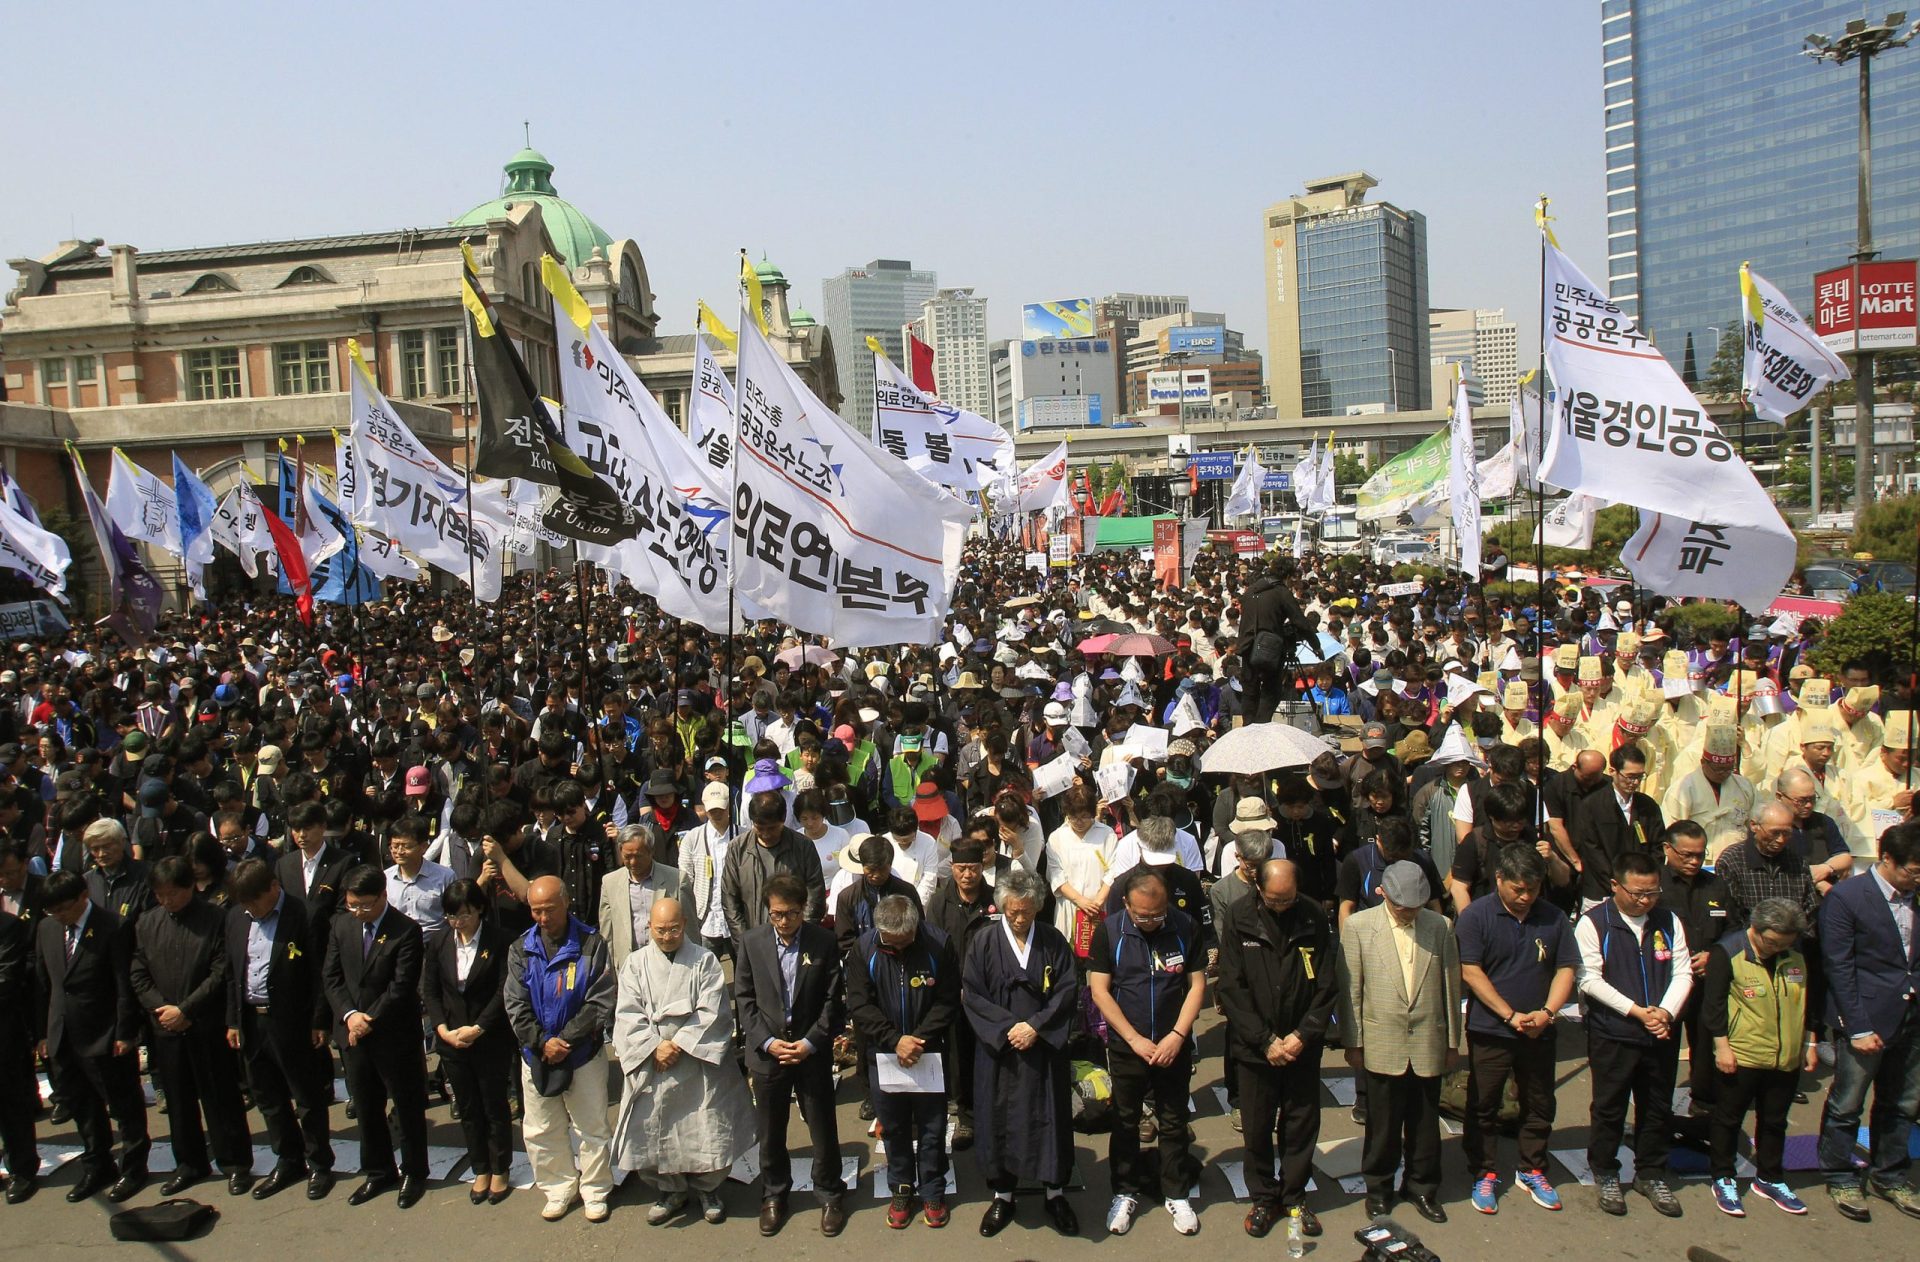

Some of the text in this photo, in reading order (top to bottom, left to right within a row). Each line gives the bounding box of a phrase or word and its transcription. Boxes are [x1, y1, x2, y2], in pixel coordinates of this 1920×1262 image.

[1819, 278, 1849, 307] 롯데
[1860, 281, 1914, 296] LOTTE
[1820, 303, 1851, 329] 마트
[1860, 295, 1914, 315] Mart
[1553, 305, 1656, 348] 공공운수
[1861, 332, 1914, 342] lottemart.com
[1191, 338, 1216, 346] BASF
[1824, 336, 1853, 347] emart.com
[877, 379, 899, 389] 민주노총
[1151, 387, 1207, 399] Panaonic
[745, 377, 783, 428] 민주노총
[740, 402, 833, 494] 공공운수노조
[566, 511, 611, 535] Union
[733, 481, 930, 615] 의료연본부
